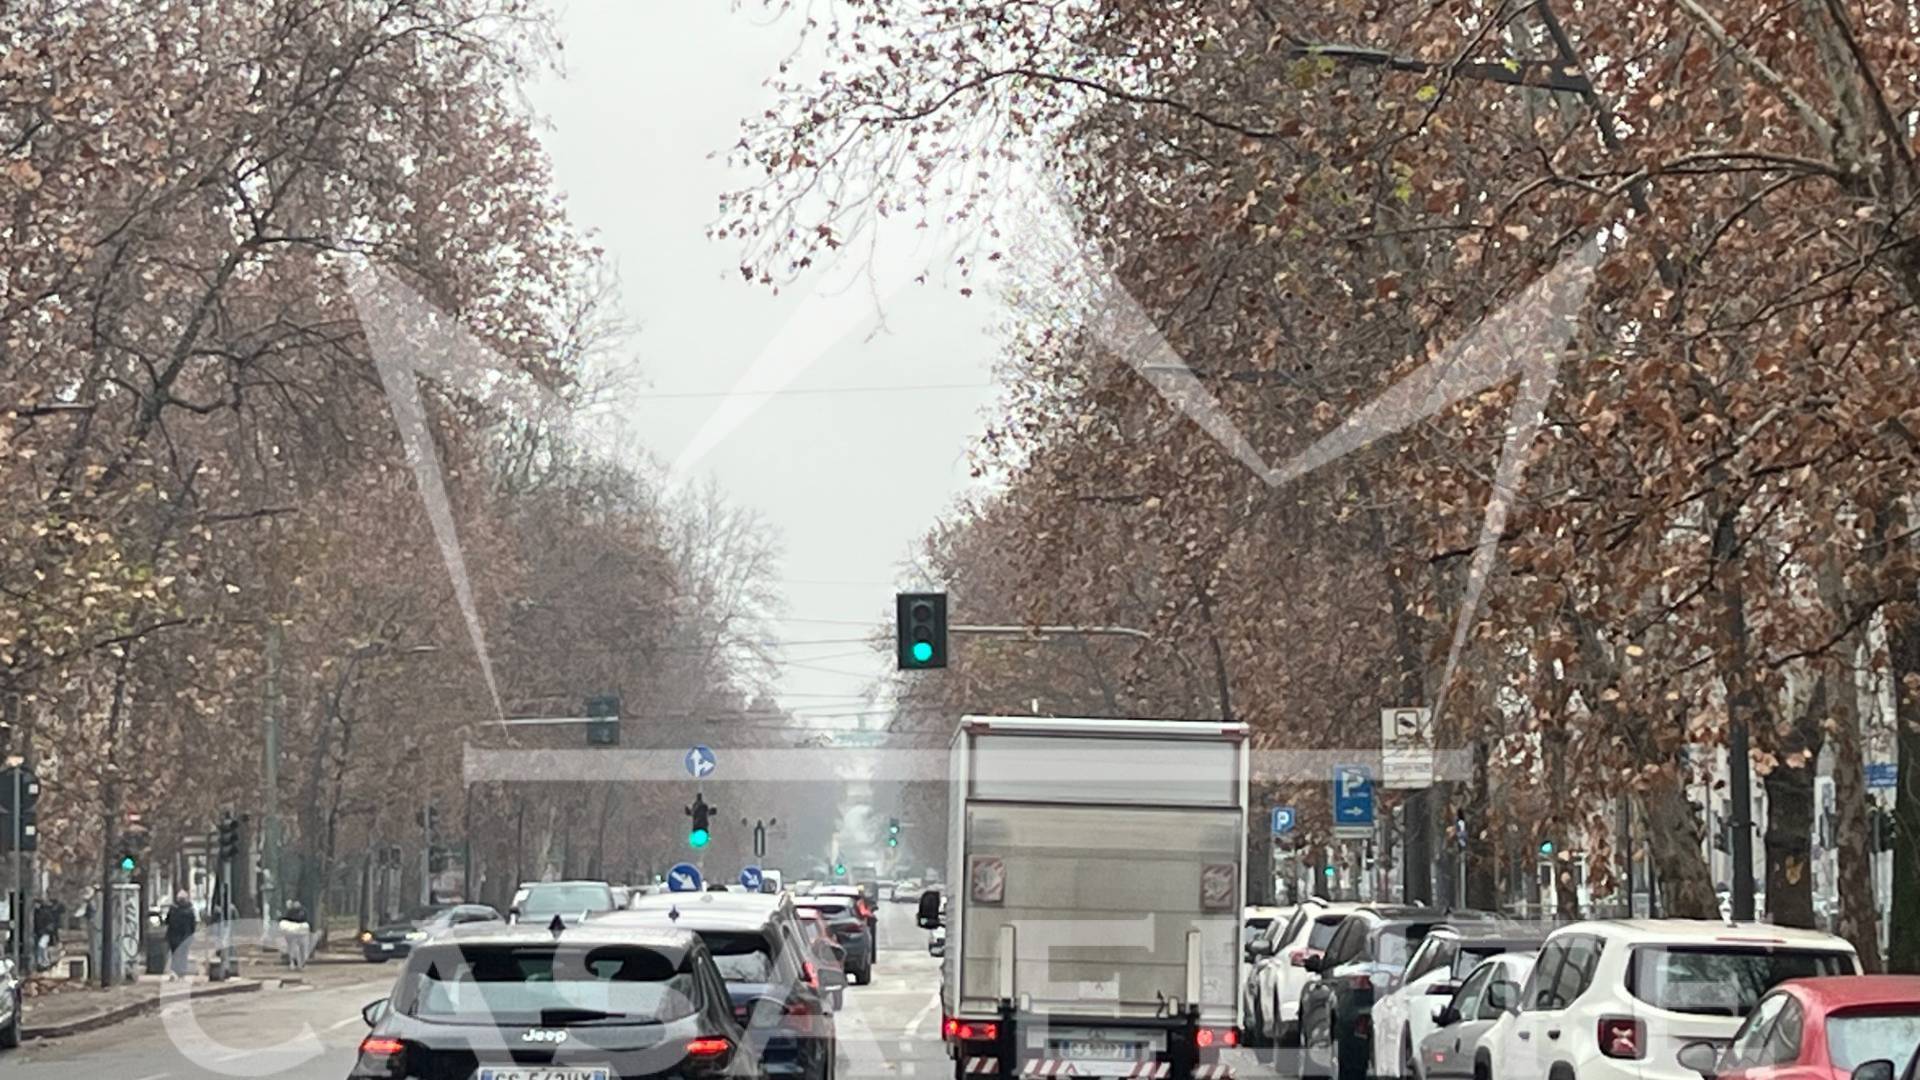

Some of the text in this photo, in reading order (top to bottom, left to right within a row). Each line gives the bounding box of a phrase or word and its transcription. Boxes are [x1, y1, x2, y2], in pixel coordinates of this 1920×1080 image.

[1341, 770, 1364, 798] P
[1276, 811, 1290, 831] P
[522, 1029, 568, 1043] Jeep
